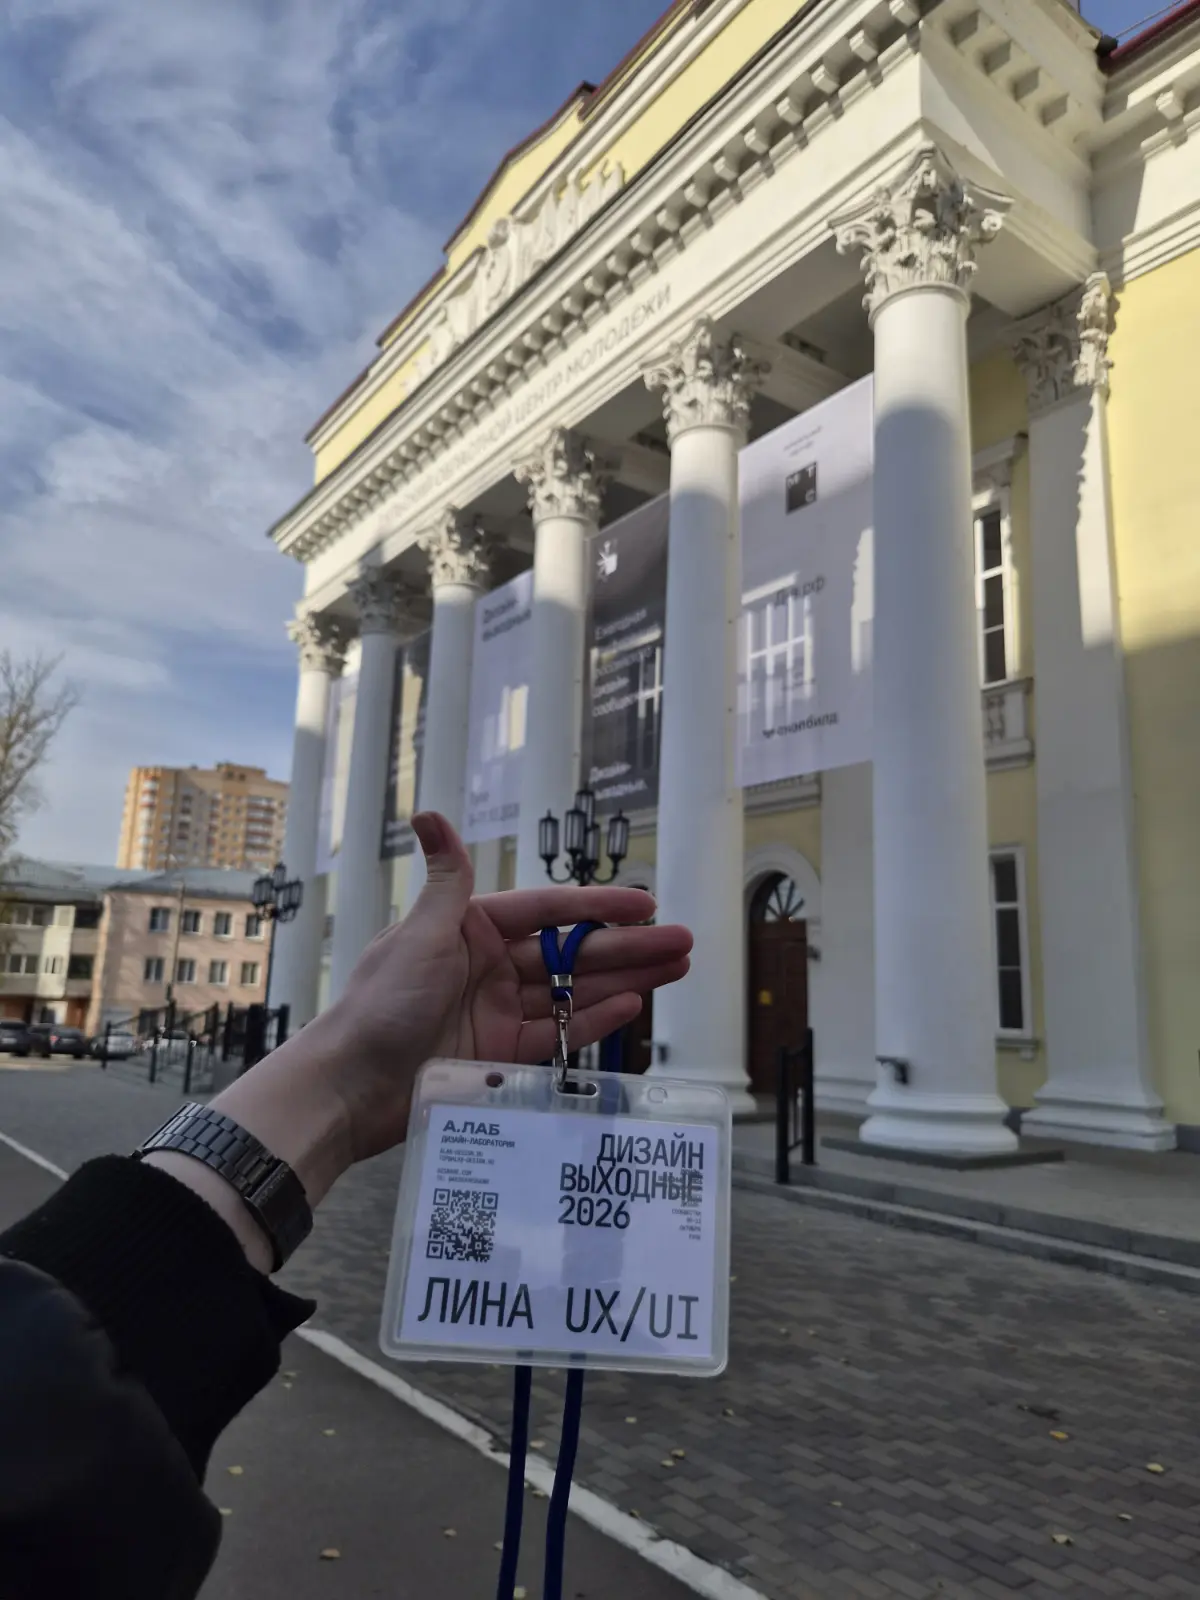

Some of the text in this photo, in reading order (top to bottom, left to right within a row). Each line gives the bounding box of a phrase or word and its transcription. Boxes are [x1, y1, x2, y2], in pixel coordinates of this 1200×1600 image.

[441, 1135, 516, 1148] ДИЗАЙН-ЛАБОРАТОРИЯ
[443, 1120, 500, 1136] А.ЛАБ
[597, 1132, 704, 1170] ДИЗАЙН
[560, 1162, 704, 1204] ВЫХОДНЫЕ
[558, 1195, 631, 1229] 2026
[417, 1276, 699, 1342] ЛИНА UX/UI
